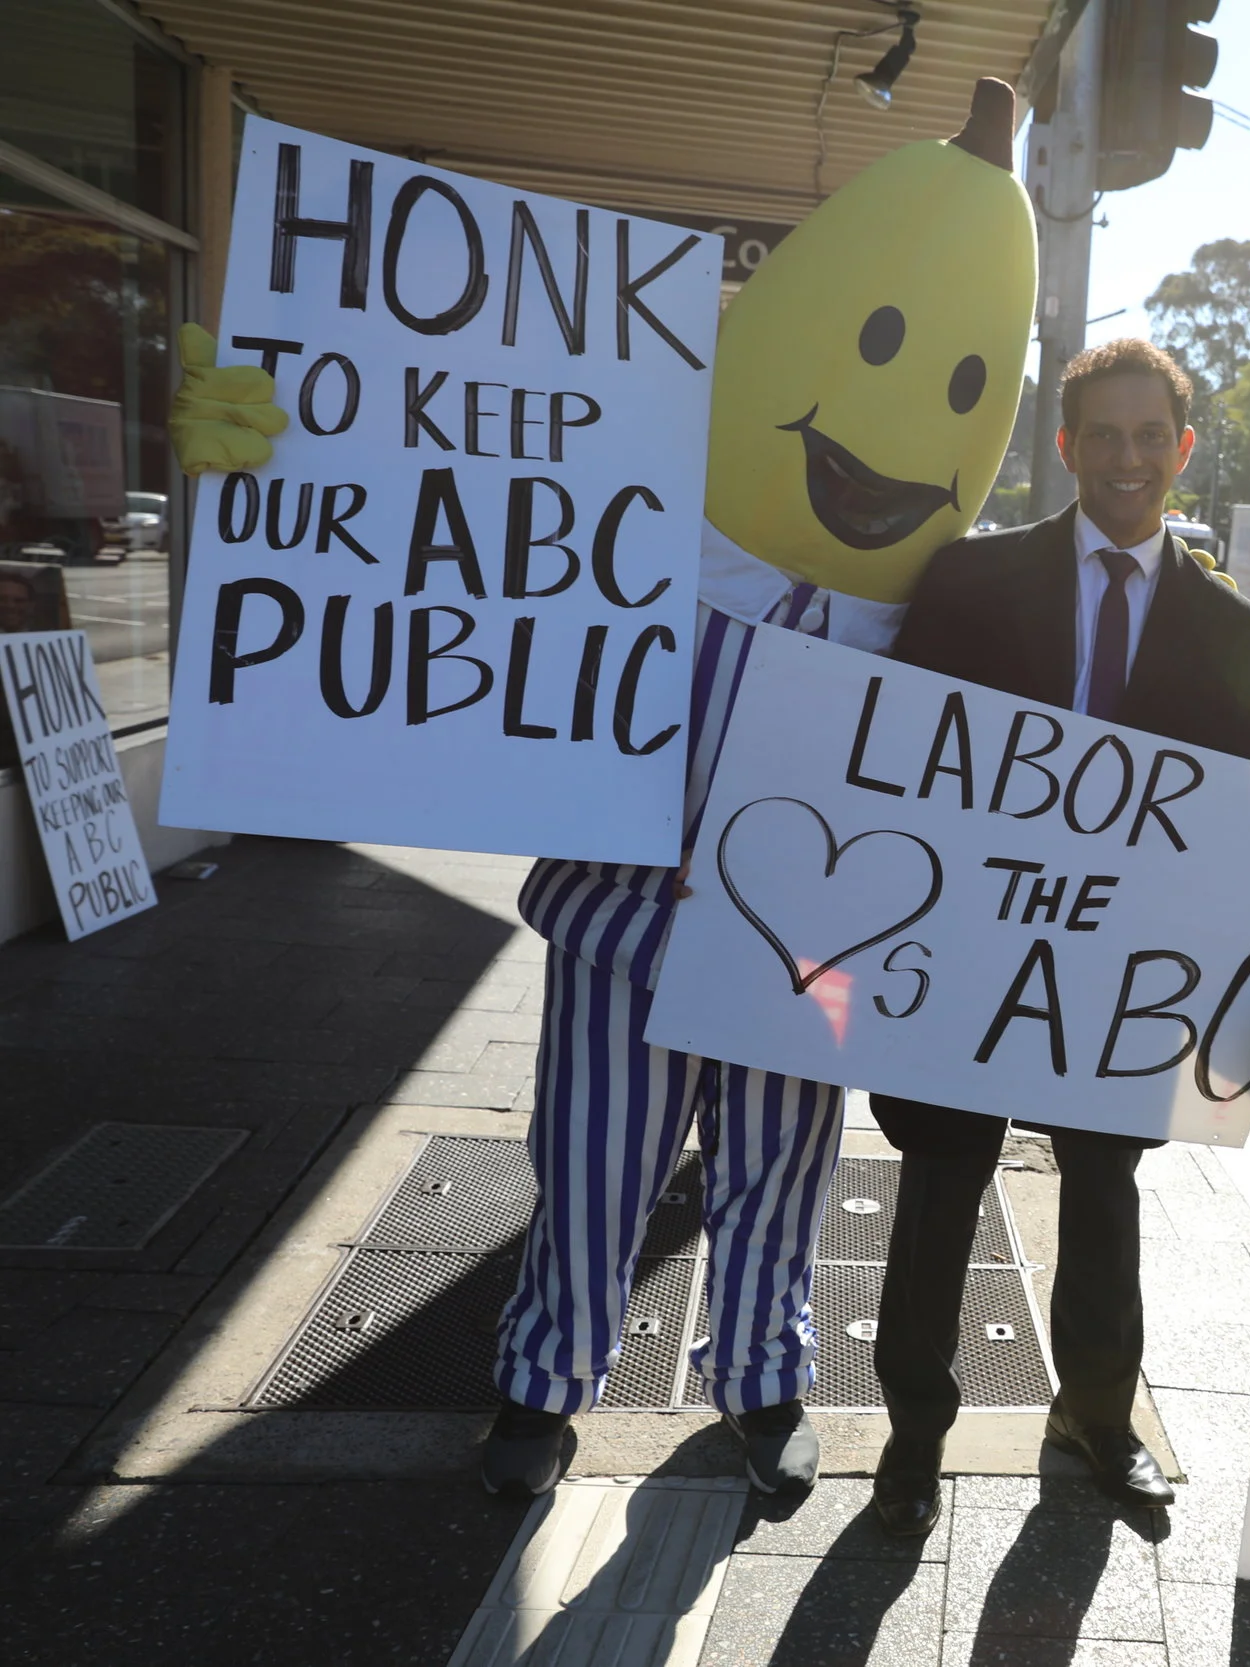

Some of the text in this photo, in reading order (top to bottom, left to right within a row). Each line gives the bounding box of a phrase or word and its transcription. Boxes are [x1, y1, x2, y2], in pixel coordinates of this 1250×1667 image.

[270, 143, 707, 371] HONK
[232, 336, 601, 462] TO KEEP
[218, 467, 672, 608] OUR ABC
[4, 635, 106, 744] HONK
[209, 577, 681, 756] PUBLIC
[24, 734, 115, 797] TO SUPPORT
[39, 779, 127, 833] KEEPING OUR
[845, 676, 1204, 852] LABOR
[68, 859, 148, 931] PUBLIC
[982, 857, 1119, 931] THE
